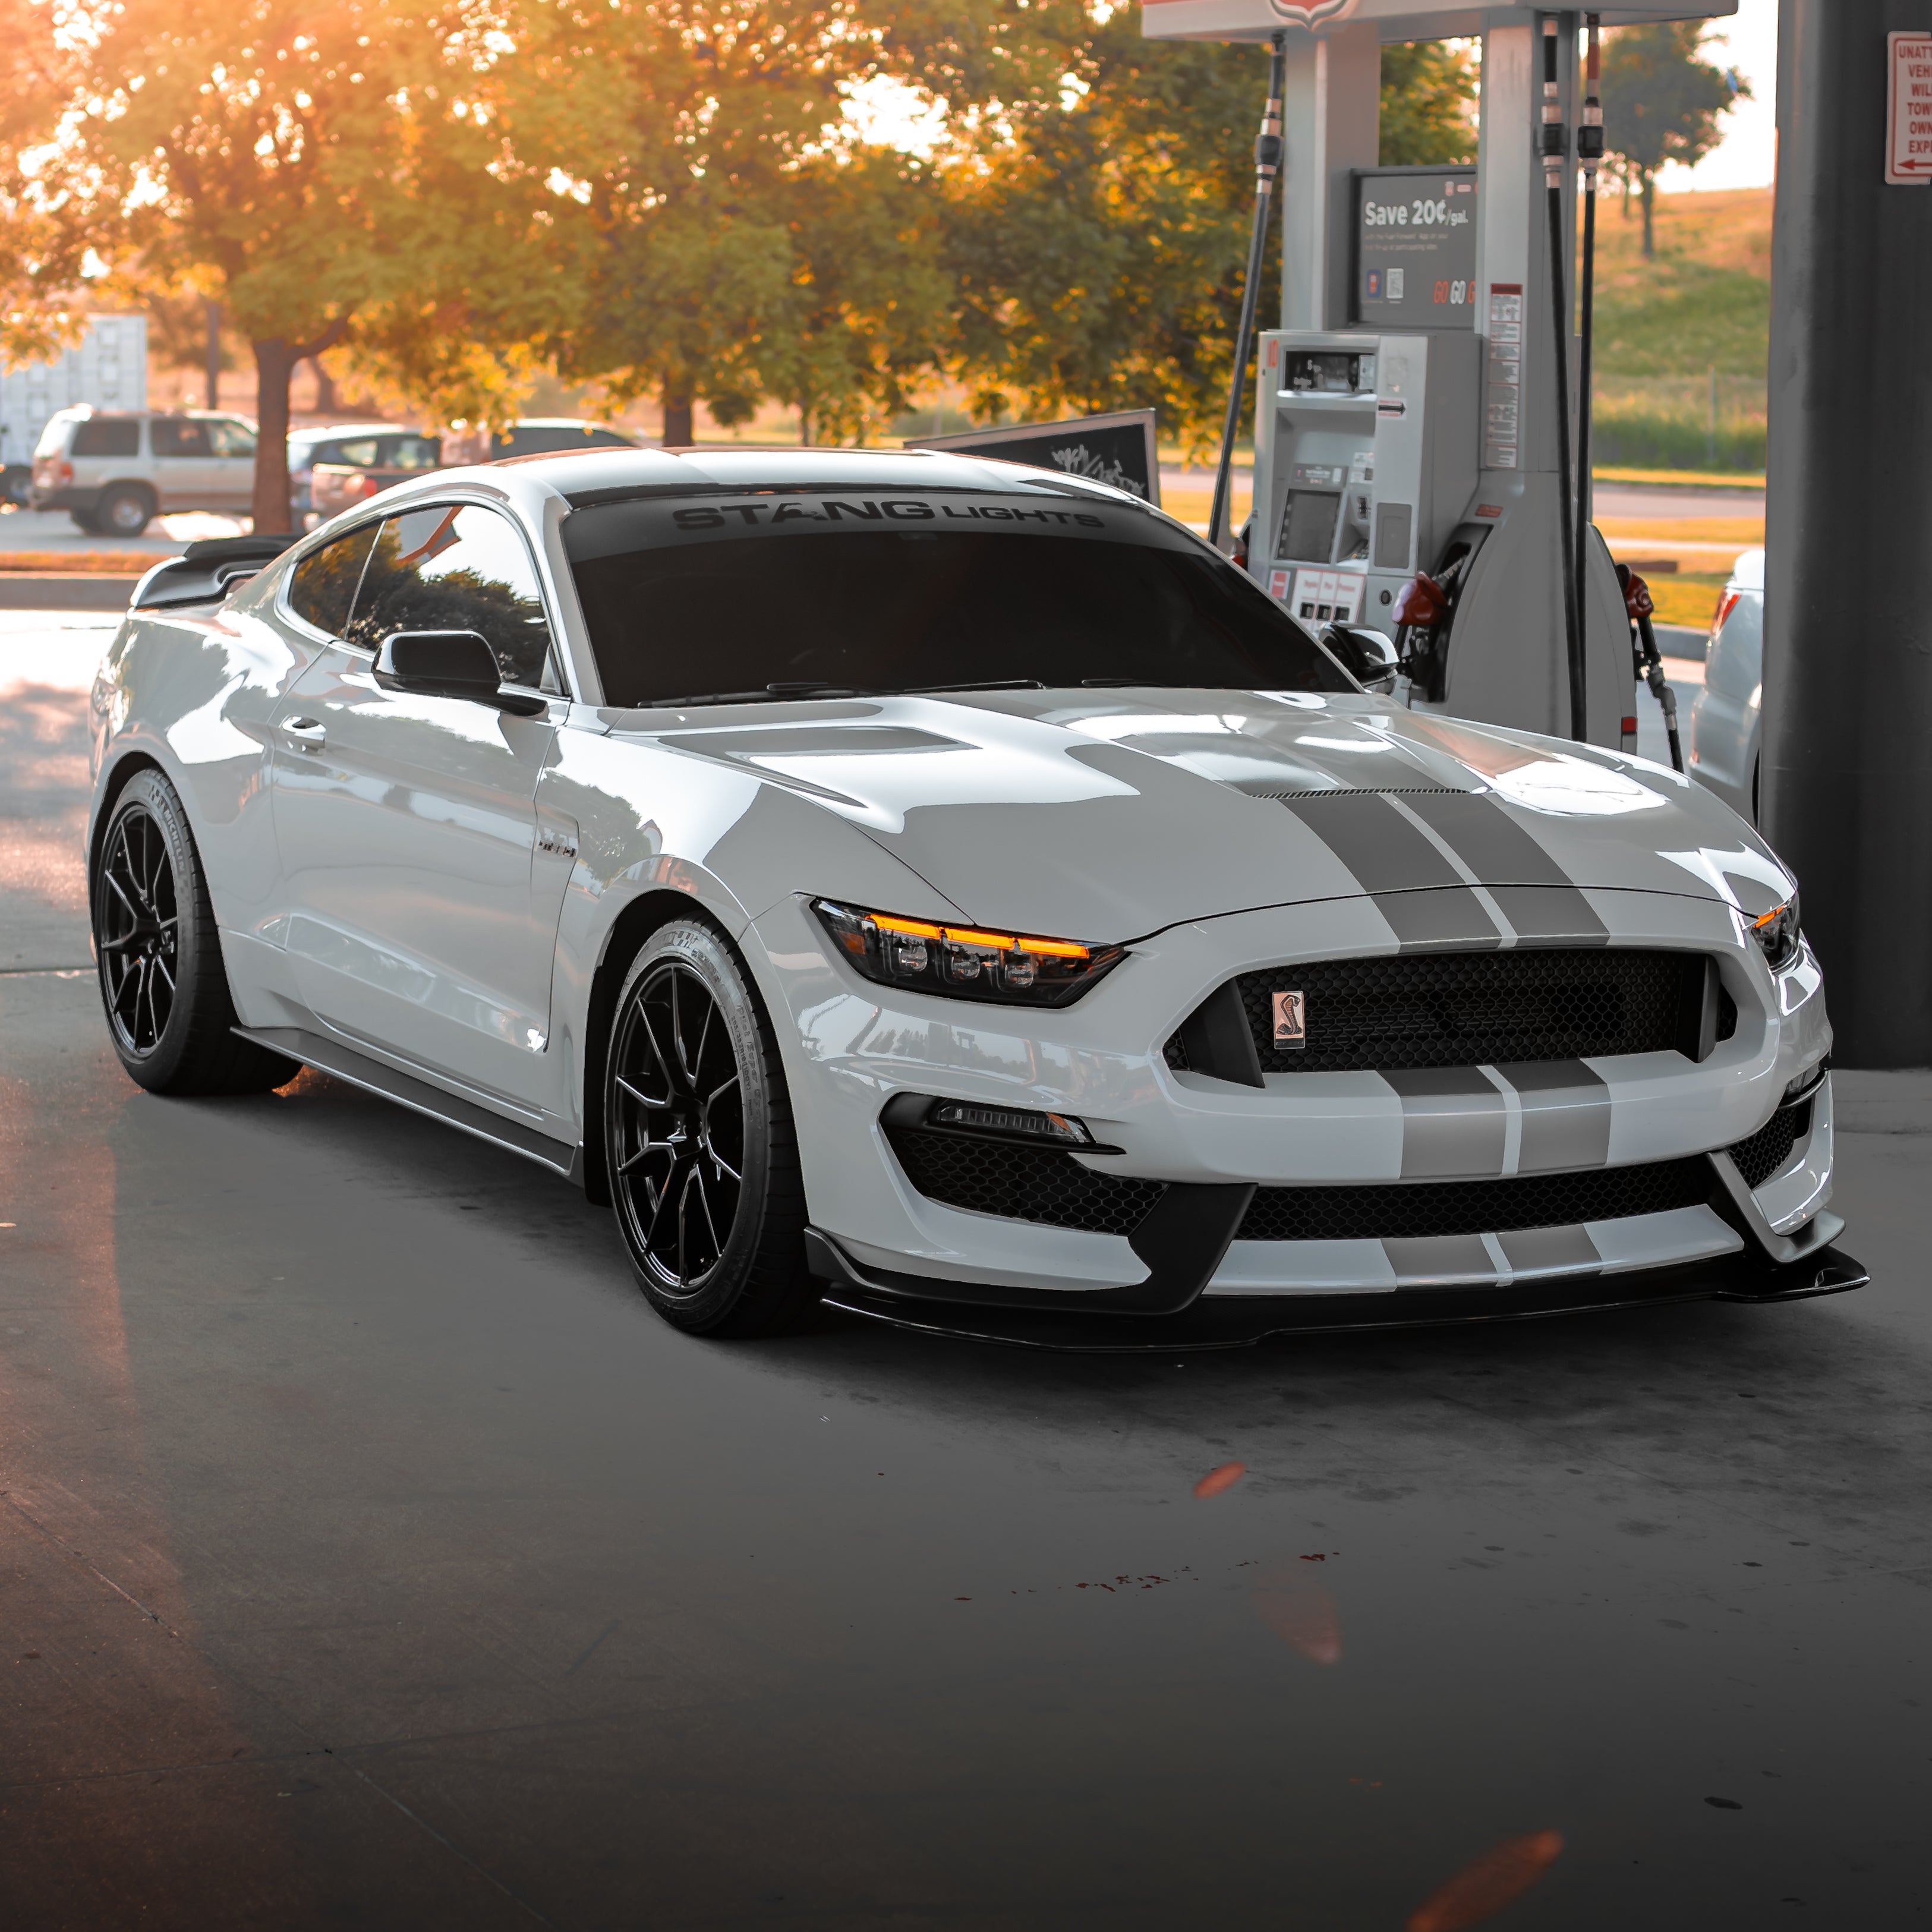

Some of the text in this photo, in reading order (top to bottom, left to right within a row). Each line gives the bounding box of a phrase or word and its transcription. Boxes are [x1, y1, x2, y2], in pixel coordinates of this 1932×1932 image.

[1365, 201, 1408, 226] Save
[1433, 280, 1449, 304] GO
[1450, 280, 1465, 304] GO
[943, 505, 1104, 528] LIGHTS
[164, 809, 185, 871] MICHELIN
